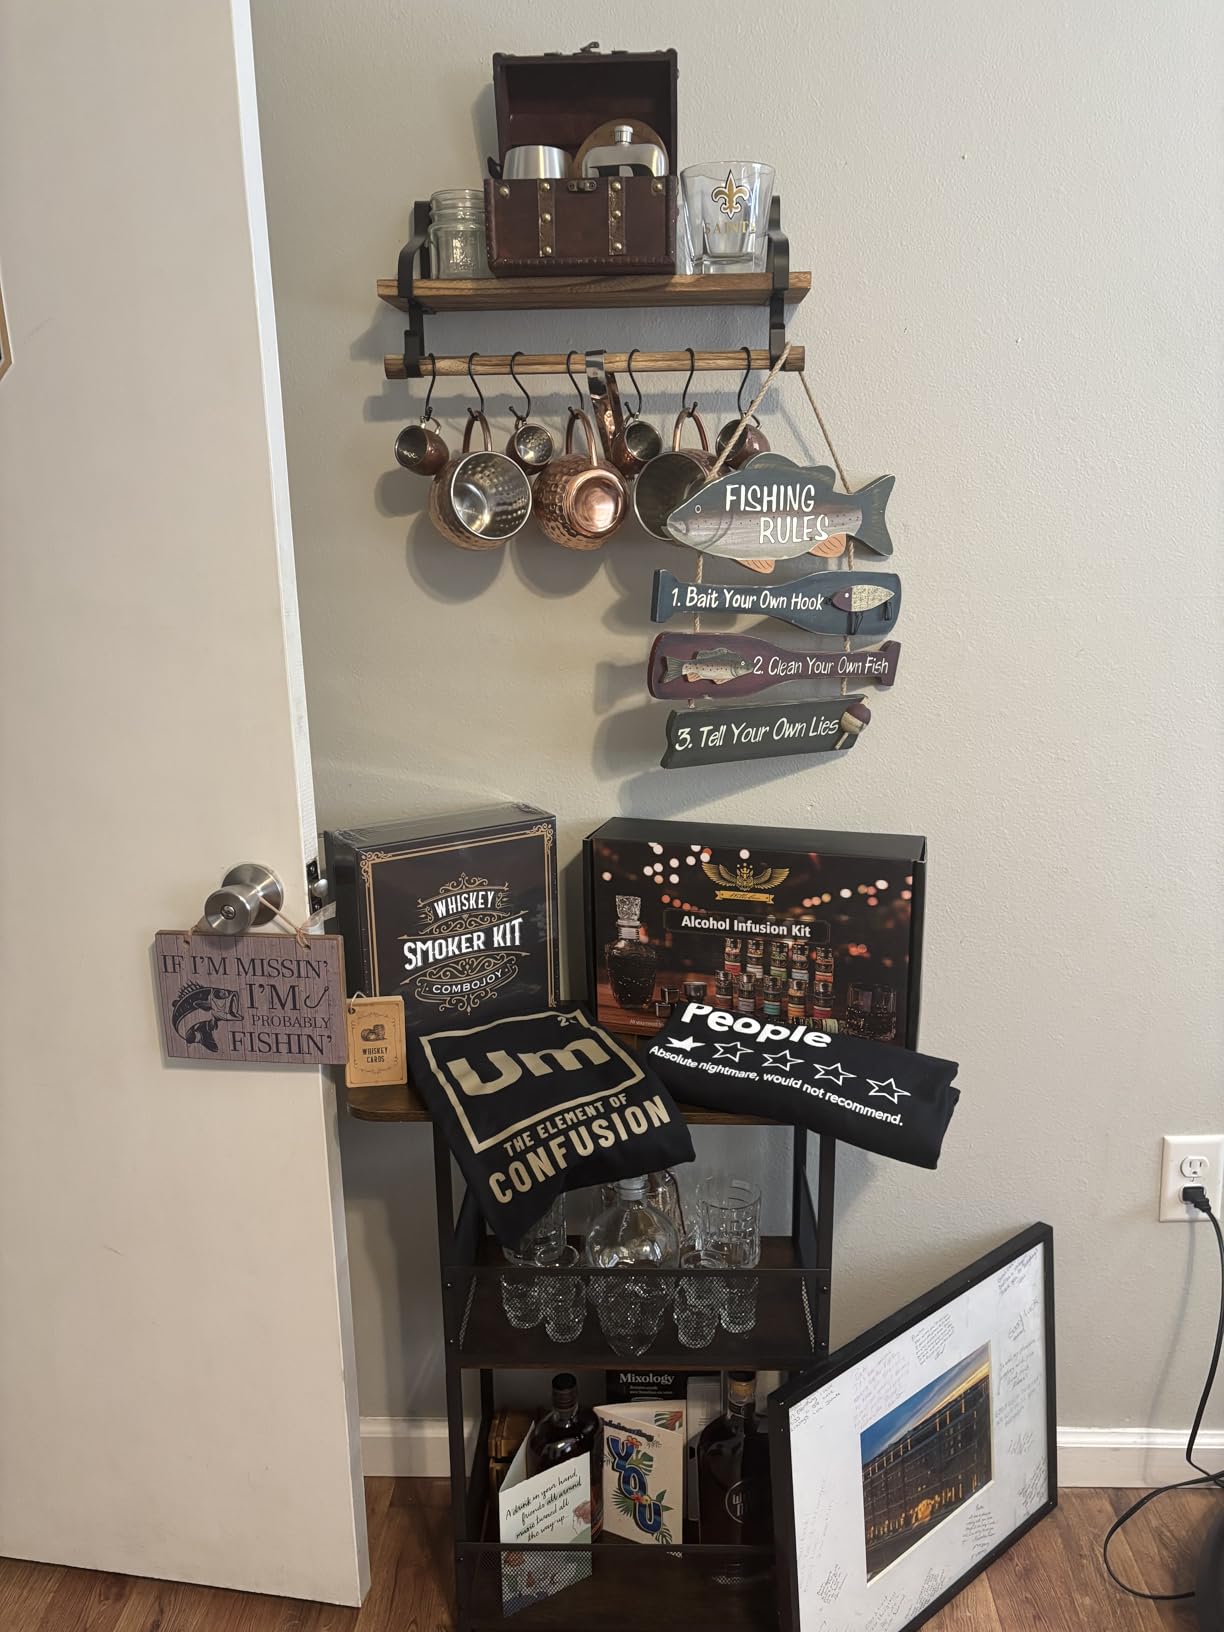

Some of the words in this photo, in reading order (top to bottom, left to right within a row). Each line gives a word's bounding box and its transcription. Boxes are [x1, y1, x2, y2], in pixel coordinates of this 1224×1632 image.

[725, 483, 816, 513] FISHING
[759, 515, 829, 544] RULES
[671, 588, 682, 607] 1.
[685, 586, 720, 608] Bait
[723, 588, 757, 609] Your
[760, 590, 787, 610] Own
[790, 592, 825, 611] Hook
[753, 656, 765, 675] 2.
[768, 656, 803, 676] Clean
[806, 656, 835, 675] Your
[838, 656, 862, 675] Own
[864, 656, 889, 675] Fish
[675, 728, 694, 751] 3.
[699, 727, 725, 748] Tell
[731, 723, 770, 744] Your
[772, 717, 806, 739] Own
[809, 715, 840, 737] Lies
[433, 890, 496, 919] WHISKEY
[681, 915, 730, 932] Alcohol
[733, 918, 788, 936] Infusion
[791, 924, 812, 938] Kit
[403, 931, 486, 971] SMOKER
[492, 917, 524, 948] KIT
[161, 954, 184, 974] IF
[190, 955, 229, 976] I'M
[235, 957, 329, 980] MISSIN'
[432, 969, 503, 994] COMBOJOY
[245, 983, 301, 1012] I'M
[251, 1015, 332, 1030] PROBABLY
[680, 1002, 833, 1048] People
[230, 1030, 333, 1056] FISHIN'
[362, 1047, 388, 1056] WHISKEY
[366, 1055, 385, 1064] CARDS
[446, 1038, 611, 1097] Um
[649, 1045, 698, 1068] Absolute
[698, 1061, 761, 1081] nightmare,
[763, 1072, 802, 1088] would
[802, 1083, 825, 1099] not
[825, 1092, 904, 1126] recommend.
[503, 1131, 535, 1157] THE
[536, 1101, 606, 1140] ELEMENT
[609, 1092, 628, 1109] OF
[488, 1095, 672, 1204] CONFUSION
[619, 1373, 675, 1385] Mixology
